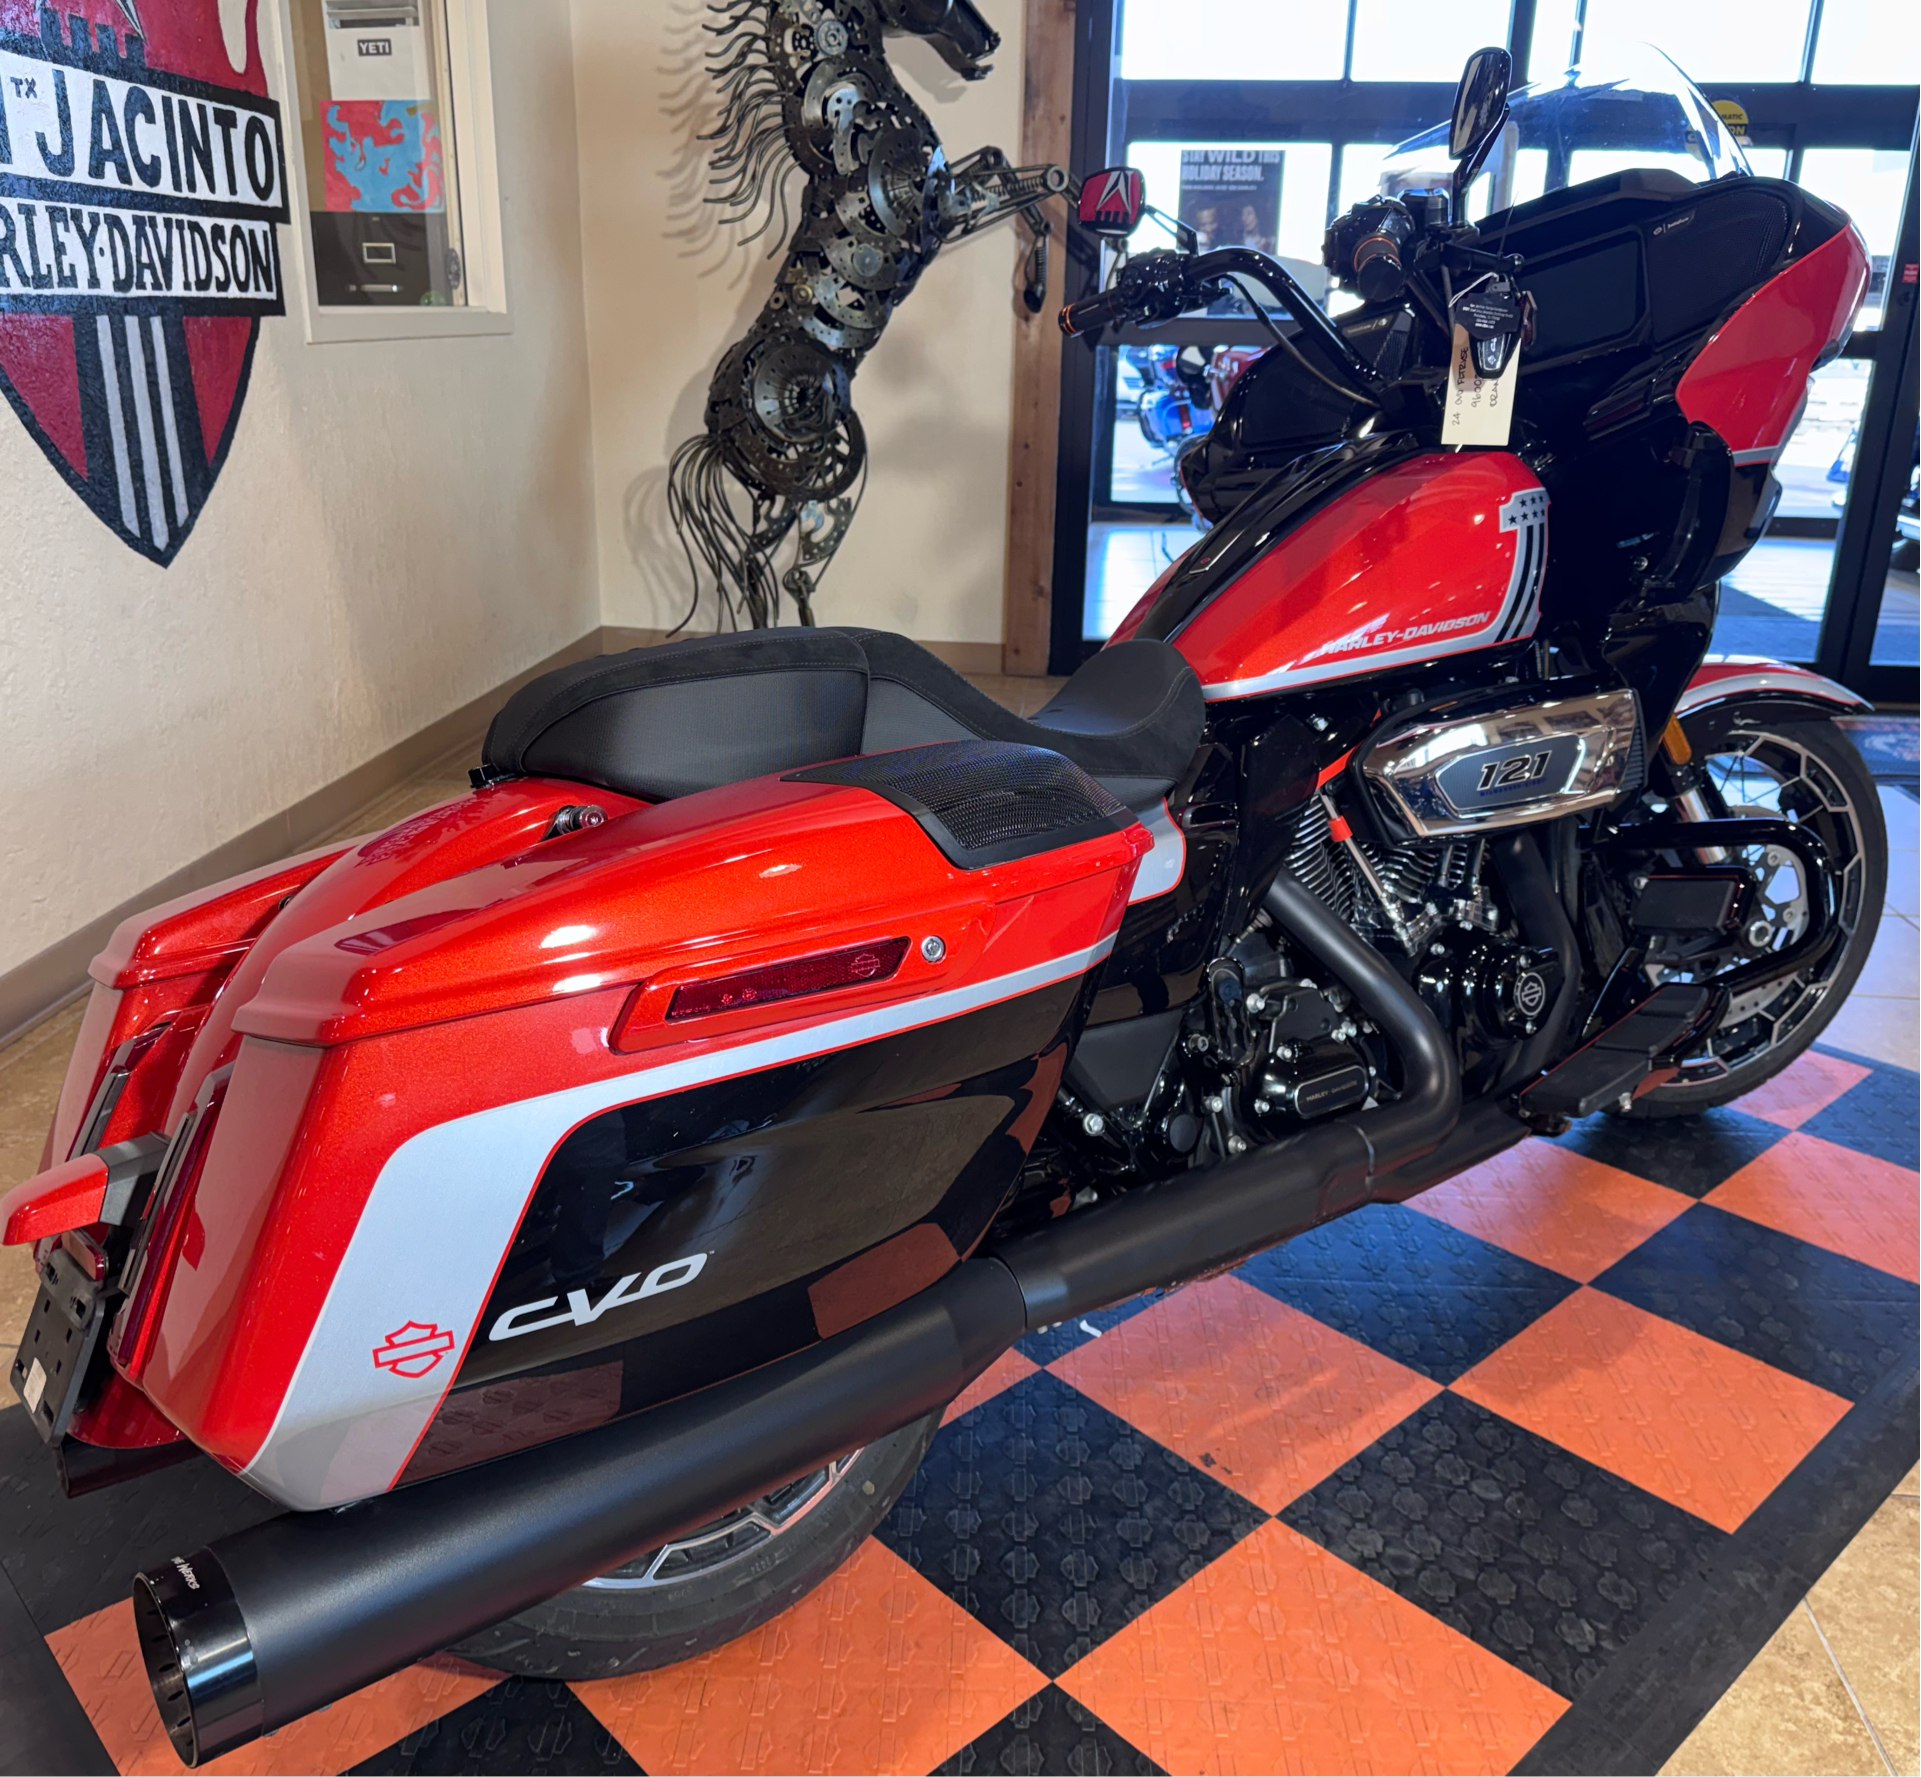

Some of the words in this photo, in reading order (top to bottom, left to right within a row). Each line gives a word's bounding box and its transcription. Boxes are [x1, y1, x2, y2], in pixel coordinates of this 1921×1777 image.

[359, 41, 390, 54] YETI
[10, 76, 38, 99] TX
[35, 68, 274, 201] JACINTO
[1206, 150, 1257, 164] WILD
[1320, 611, 1491, 654] HARLEY-DAVIDSON
[1477, 750, 1552, 791] 121
[489, 1252, 708, 1342] CVO
